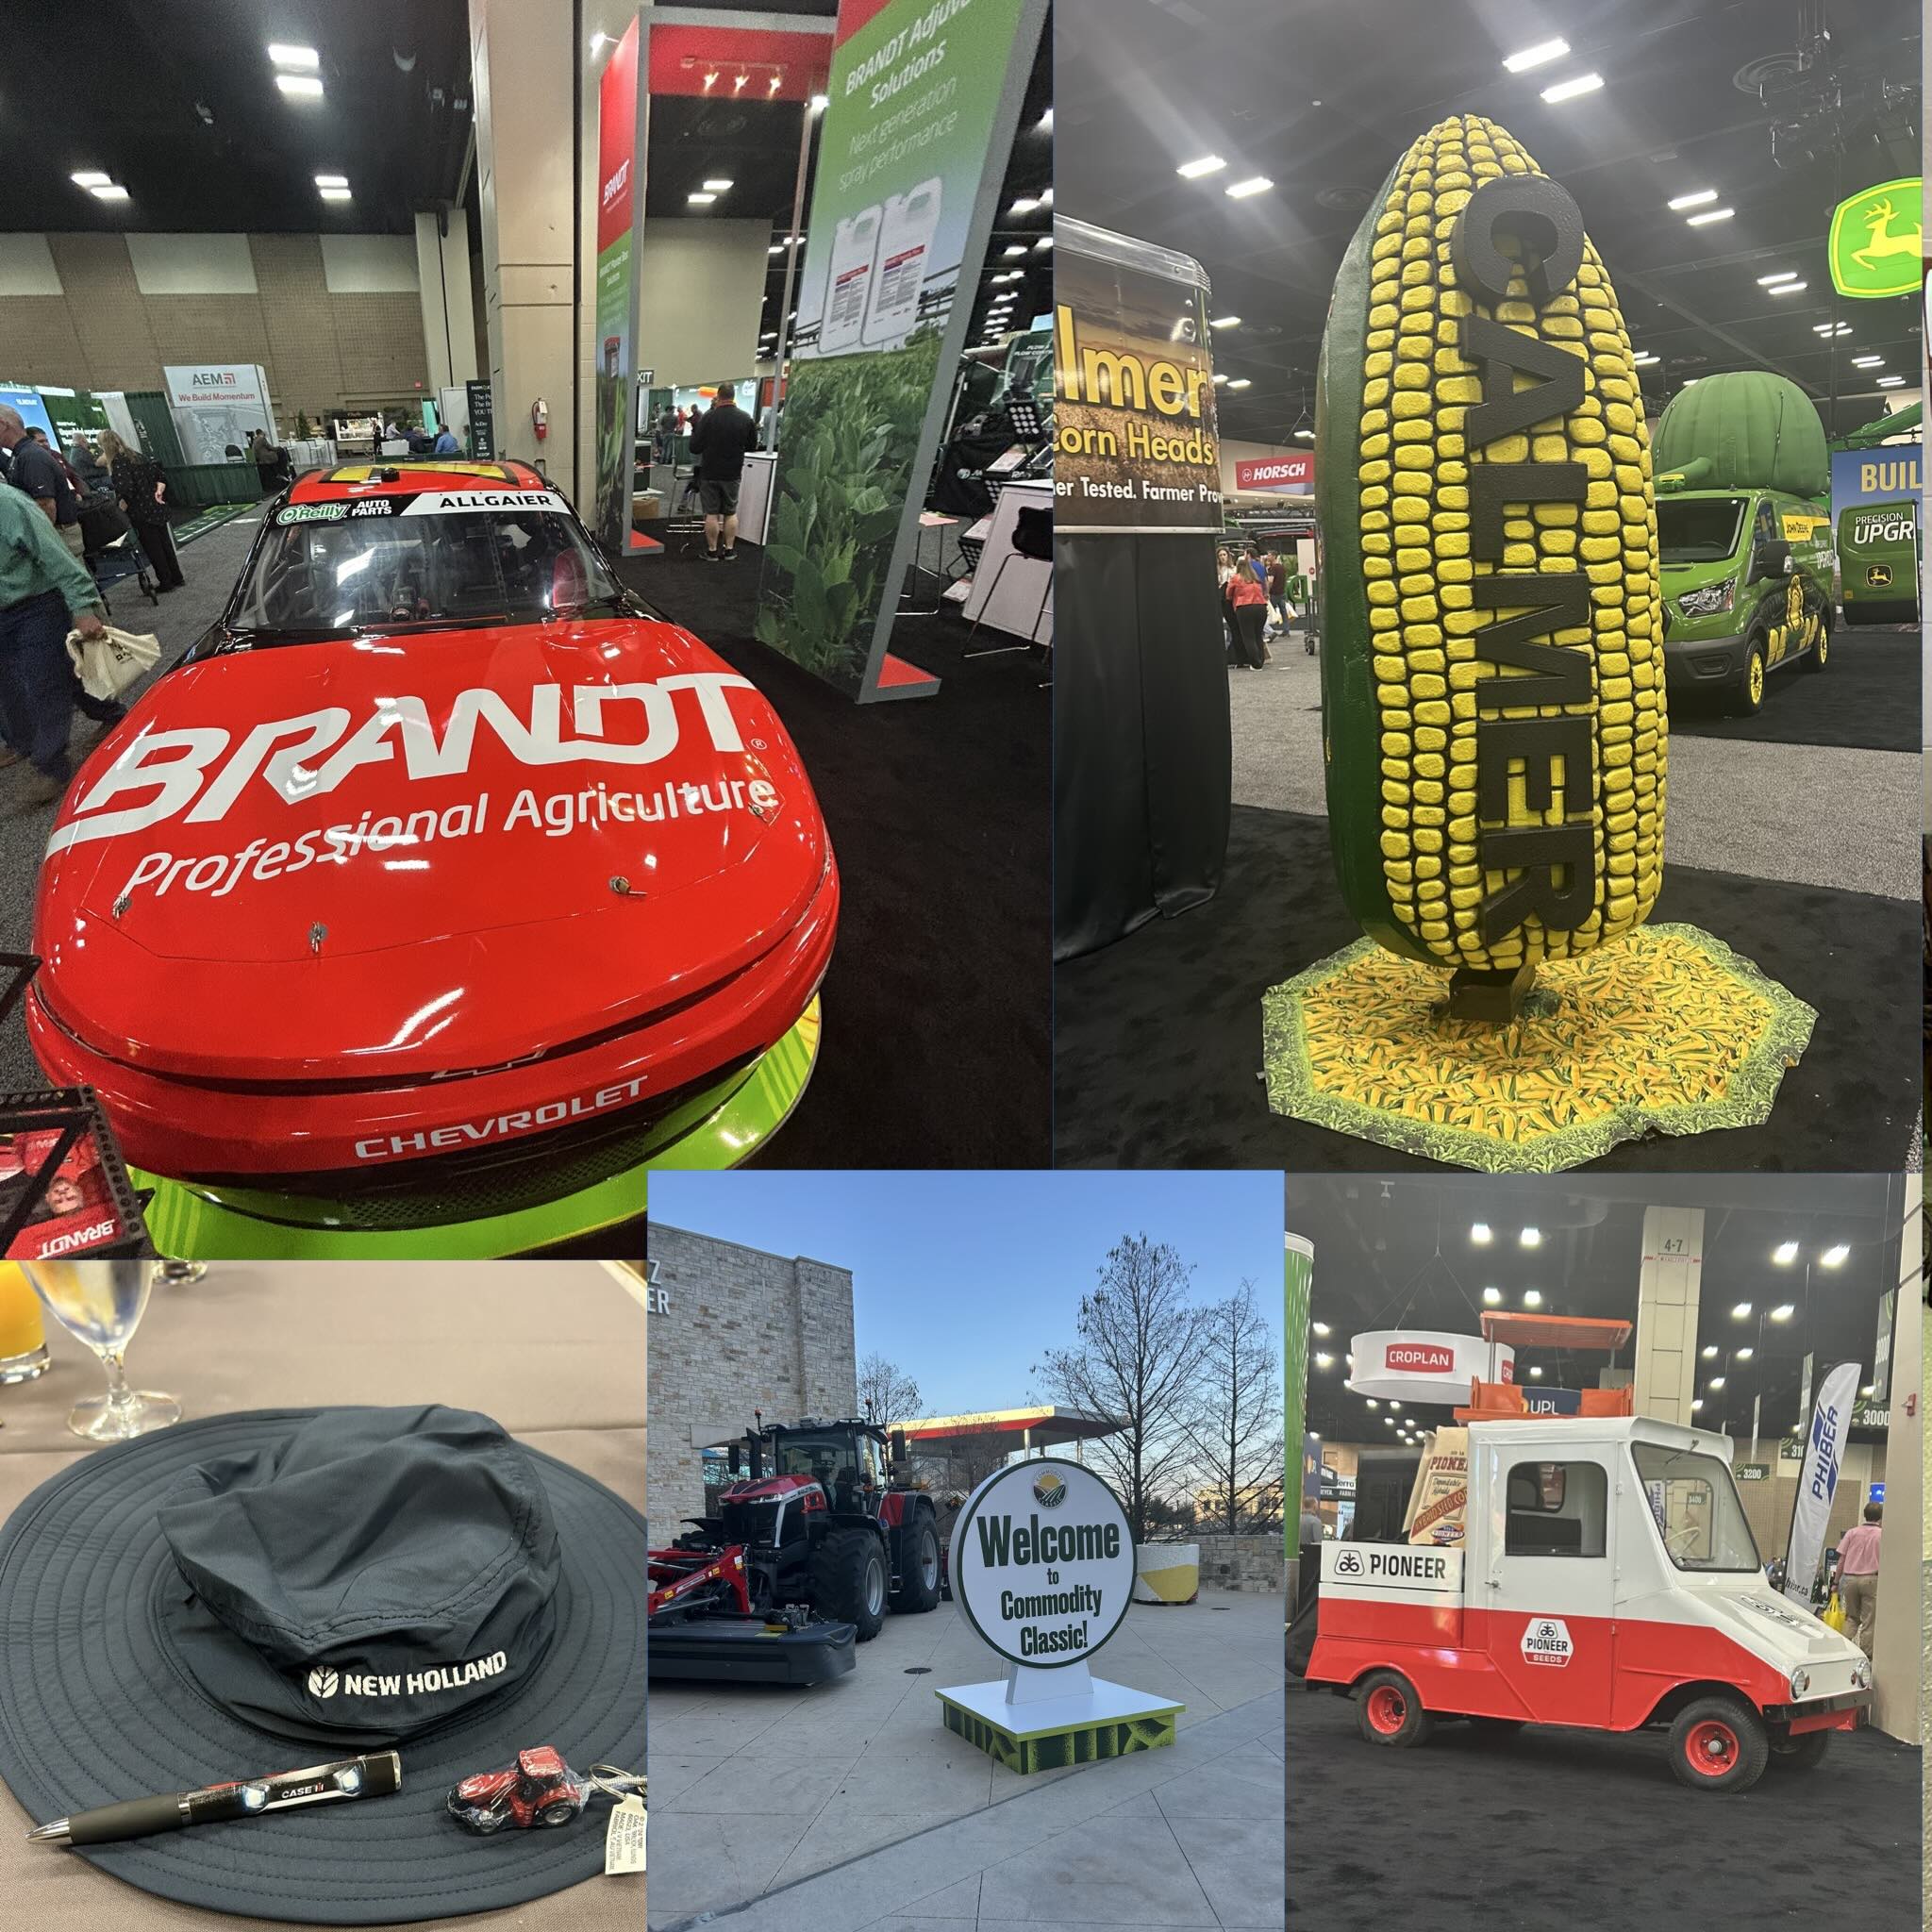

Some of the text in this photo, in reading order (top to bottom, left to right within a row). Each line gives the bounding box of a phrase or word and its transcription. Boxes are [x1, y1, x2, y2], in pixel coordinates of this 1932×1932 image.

[846, 27, 908, 95] BRANDT
[870, 39, 946, 109] Solutions
[849, 76, 957, 156] Next generation
[839, 110, 958, 192] spray performance
[1054, 305, 1208, 418] lmer
[193, 374, 223, 385] AEM
[179, 393, 191, 402] We
[213, 392, 256, 401] Momentum
[1126, 423, 1214, 465] Heads
[1253, 463, 1306, 480] HORSCH
[1861, 460, 1923, 492] BUIL
[440, 494, 553, 508] ALLGAIER
[1054, 481, 1074, 496] er
[1080, 476, 1137, 499] Tested.
[1142, 481, 1194, 502] Farmer
[277, 503, 349, 525] O'Reilly
[352, 506, 392, 516] PARTS
[357, 499, 390, 508] AUTO
[1856, 512, 1904, 525] PRECISION
[1855, 521, 1915, 544] UPGR
[1453, 175, 1594, 941] CALMER
[47, 673, 760, 860] BRANDT
[124, 775, 779, 897] Professional Agriculture
[355, 1075, 648, 1159] CHEVROLET
[36, 1219, 115, 1260] BRANDT
[1664, 1239, 1683, 1252] 4-7
[1390, 1350, 1449, 1366] CROPLAN
[1530, 1399, 1559, 1414] UPL
[1863, 1410, 1890, 1426] 3000
[1430, 1457, 1468, 1472] PIONE
[1812, 1406, 1838, 1500] PHIBER
[1743, 1468, 1762, 1479] 3200
[976, 1513, 1120, 1568] Welcome
[1047, 1568, 1059, 1585] to
[1370, 1554, 1446, 1579] PIONEER
[1001, 1585, 1102, 1621] Commodity
[1021, 1620, 1089, 1657] Classic!
[1526, 1638, 1568, 1652] PIONEER
[1533, 1654, 1562, 1663] SEEDS
[344, 1651, 508, 1697] NEW HOLLAND
[281, 1786, 312, 1799] CASE
